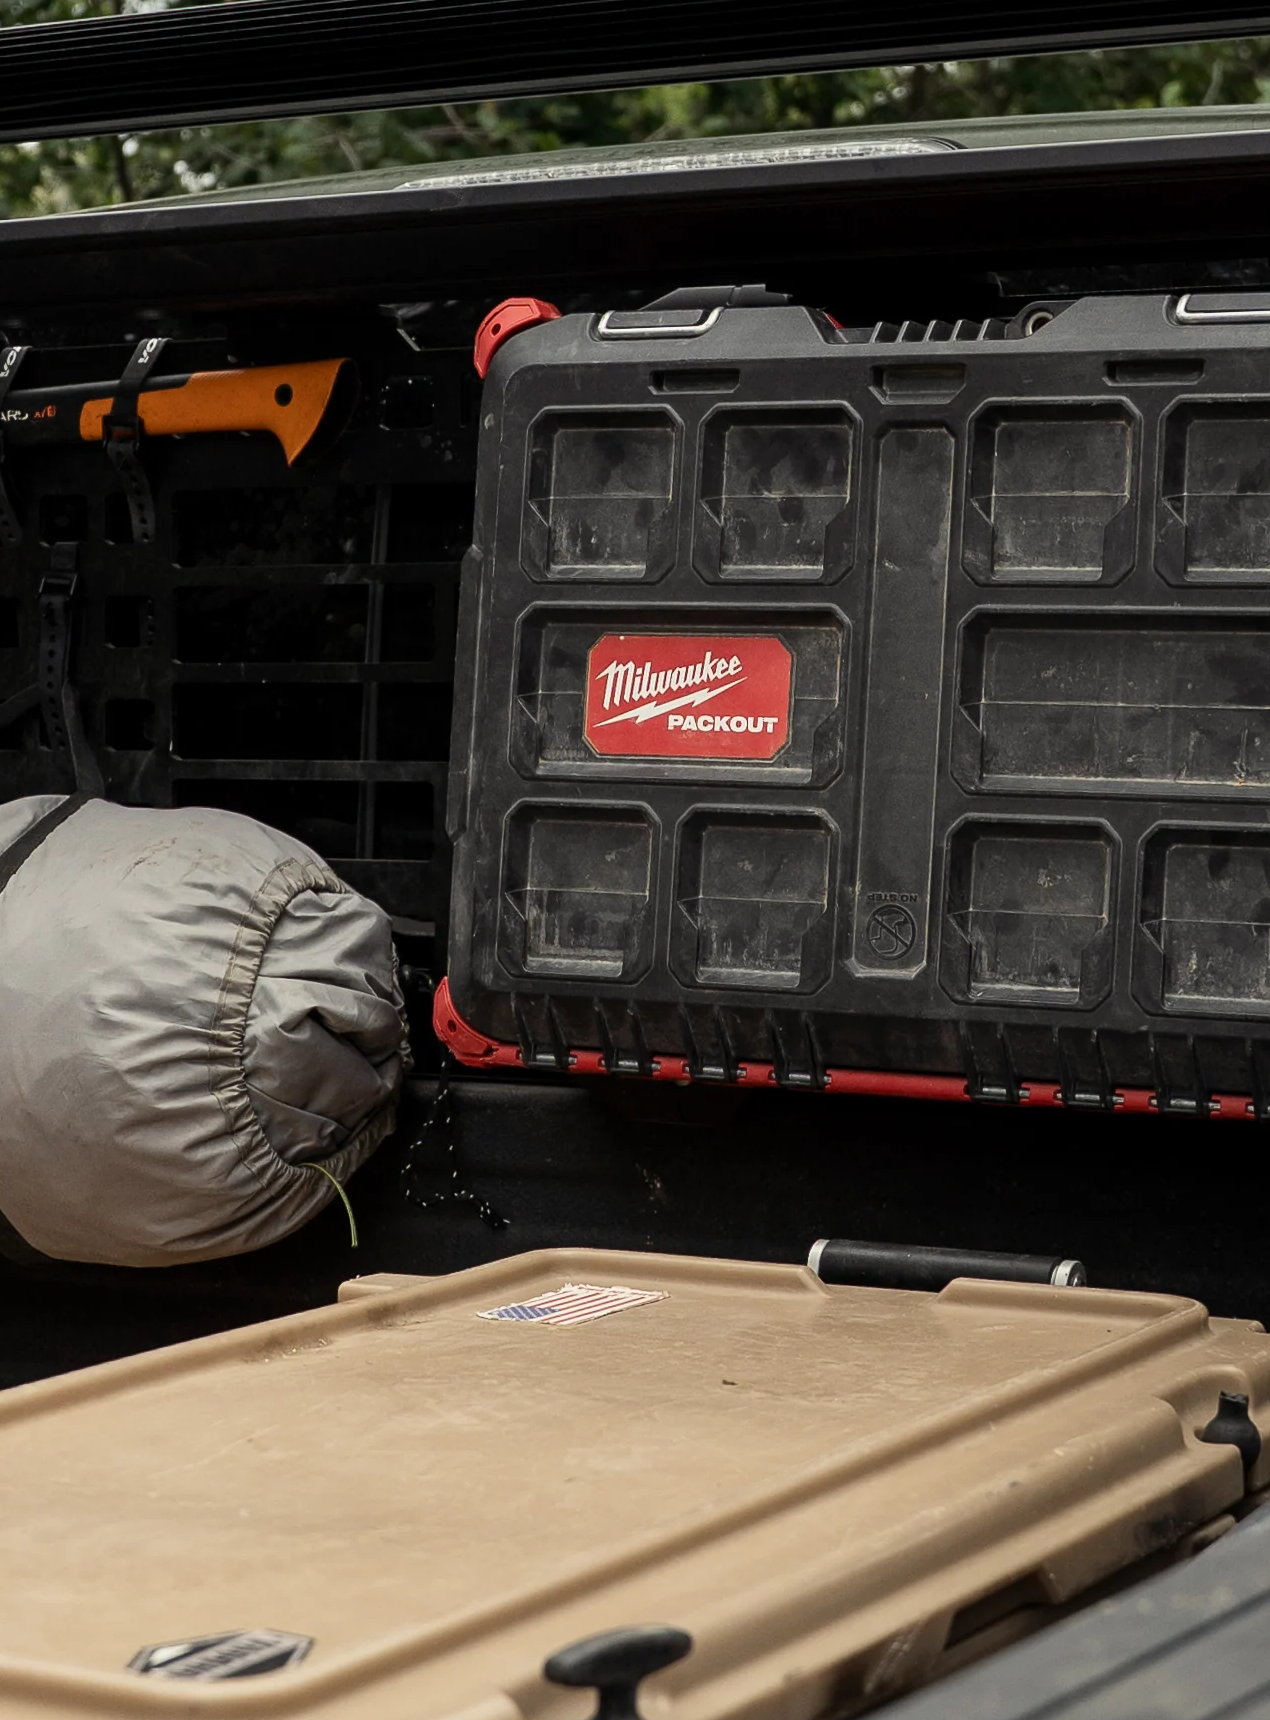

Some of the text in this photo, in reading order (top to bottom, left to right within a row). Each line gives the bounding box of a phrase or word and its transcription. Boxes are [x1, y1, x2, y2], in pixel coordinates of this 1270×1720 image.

[595, 651, 743, 710] Milwaukee
[667, 714, 779, 733] PACKOUT
[900, 893, 918, 902] NO
